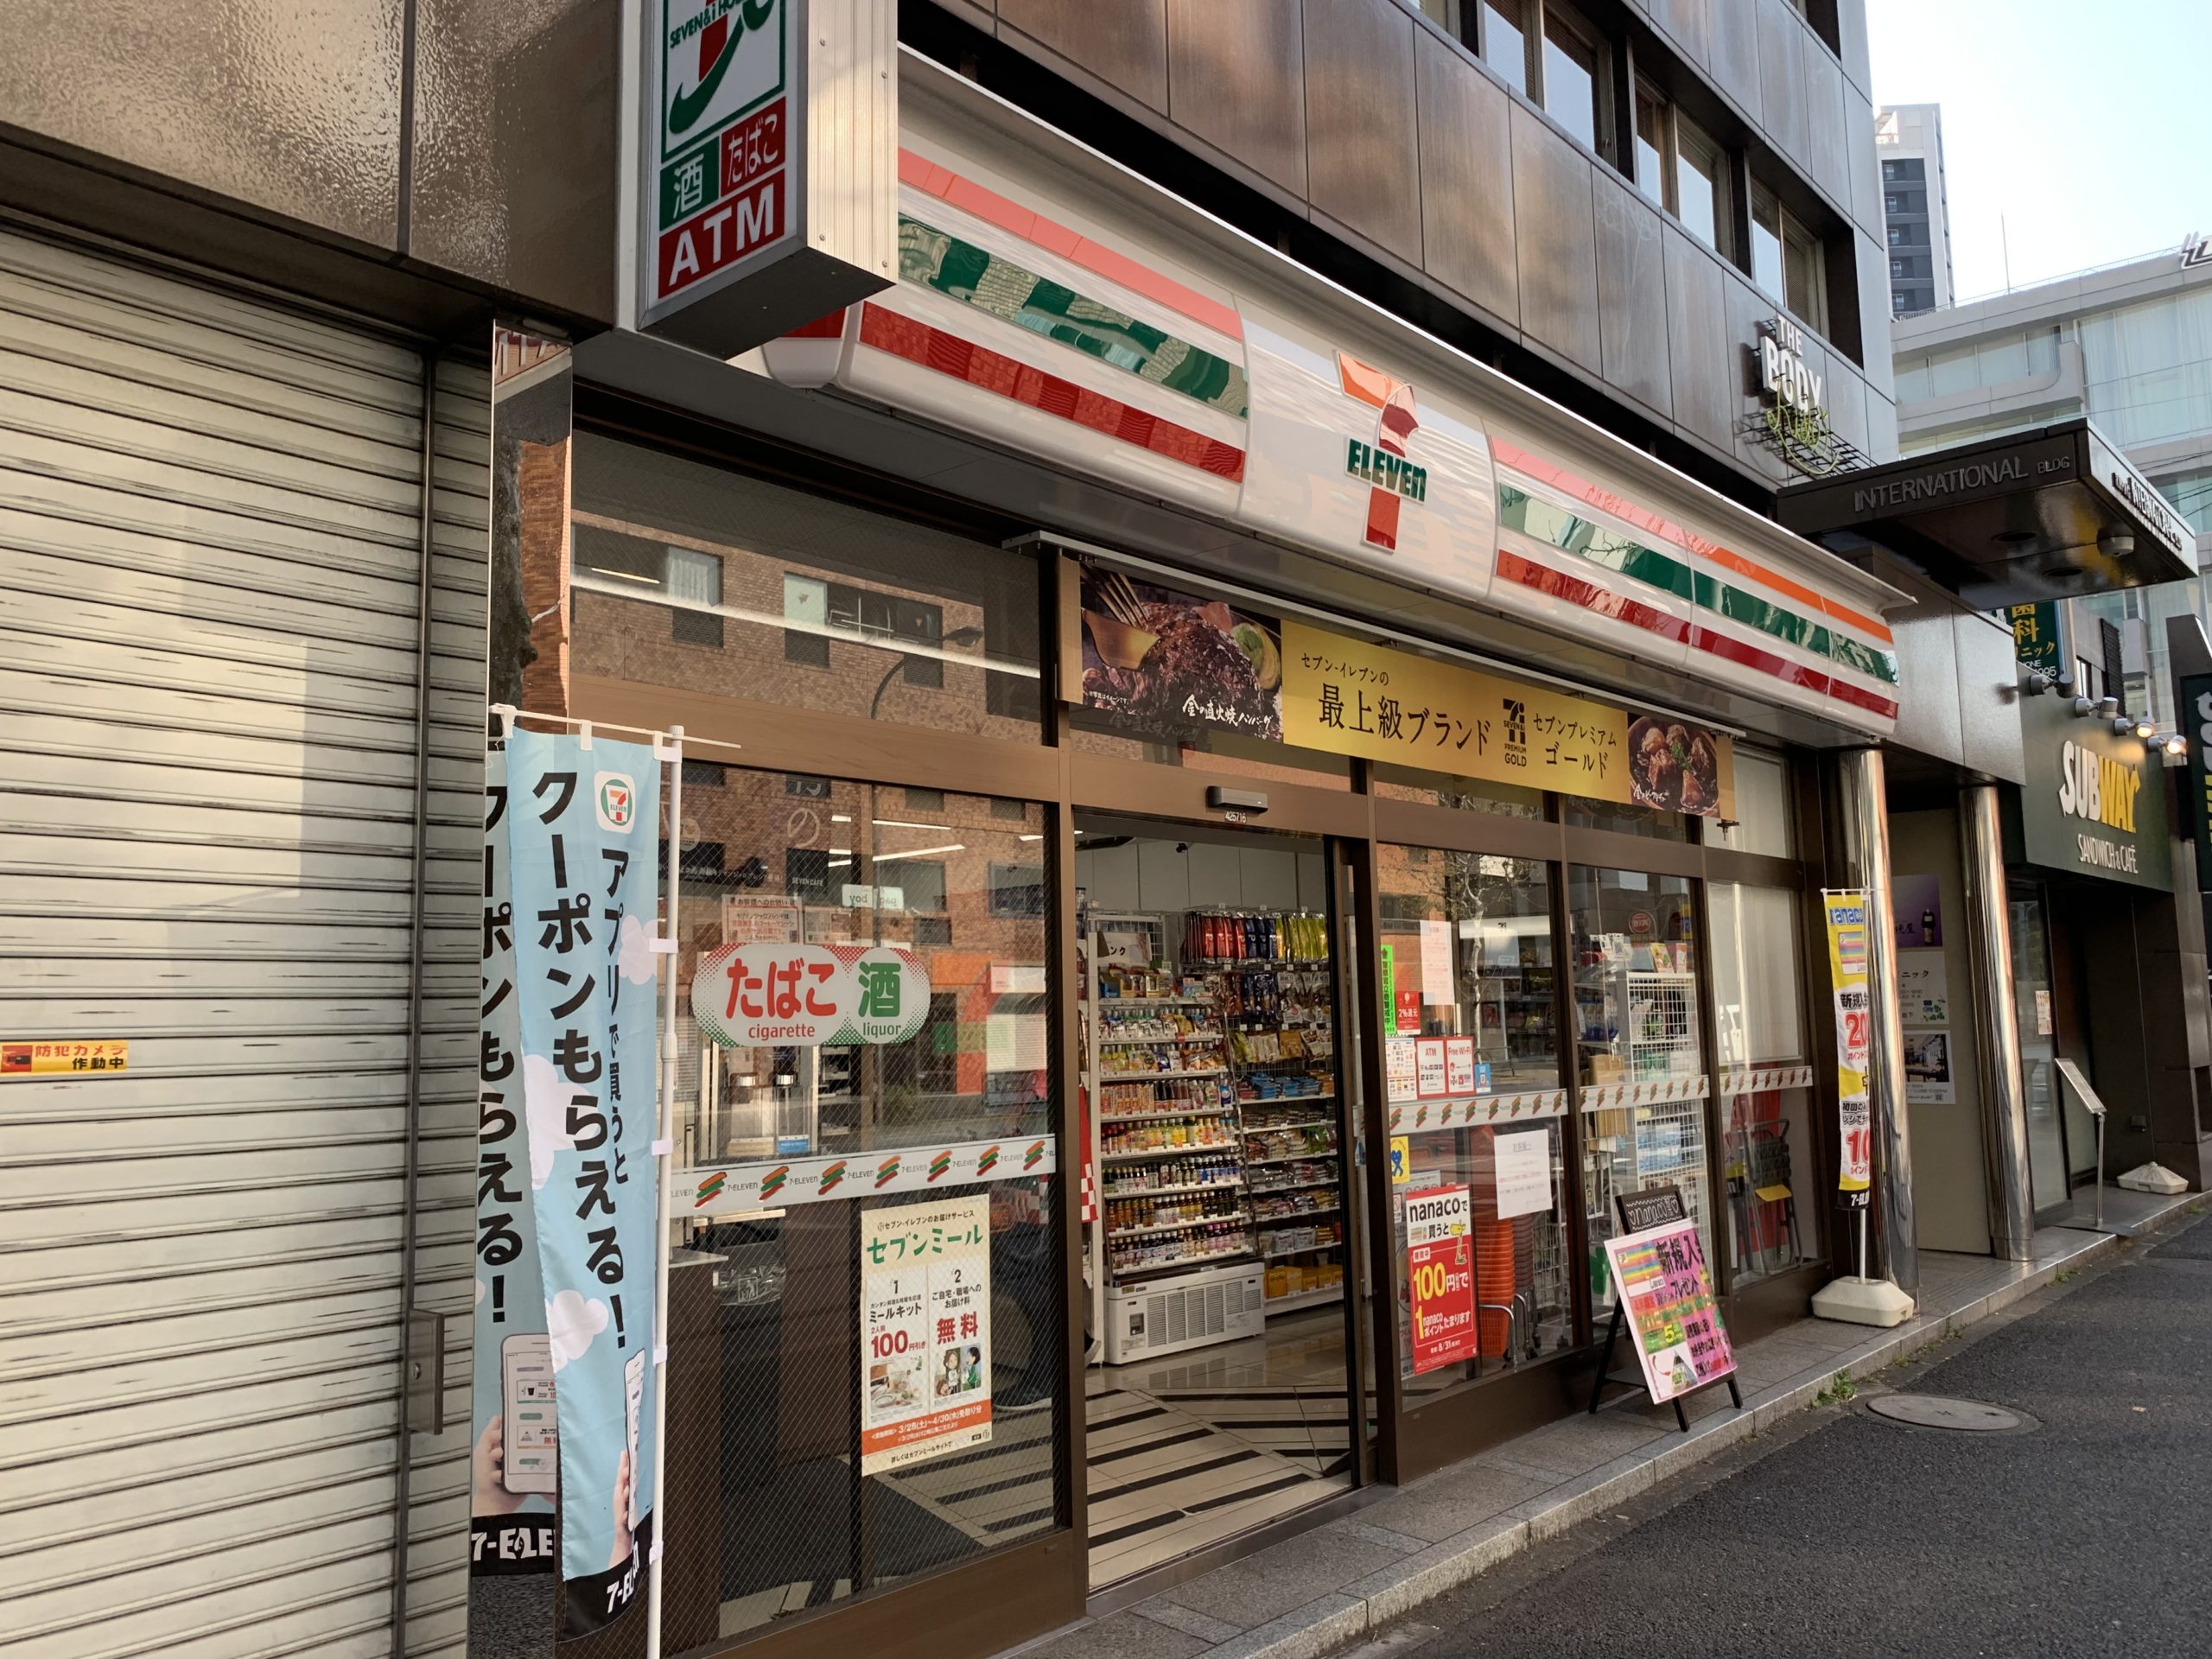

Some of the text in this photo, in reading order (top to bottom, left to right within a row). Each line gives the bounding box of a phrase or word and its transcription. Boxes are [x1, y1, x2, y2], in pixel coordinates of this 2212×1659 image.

[728, 113, 778, 188] たばこ
[673, 153, 704, 219] 酒
[668, 182, 775, 287] ATM
[1776, 315, 1802, 358] THE
[1761, 336, 1821, 420] BODY
[1854, 455, 2070, 512] INTERNATIONAL BLDG
[1318, 682, 1491, 757] 最上級ブランド
[1533, 713, 1617, 747] セブンプレミアム
[1504, 742, 1527, 754] PREMIUM
[1504, 753, 1527, 767] GOLD
[1546, 741, 1608, 779] ゴールド
[2058, 740, 2140, 833] SUBWAY
[1225, 811, 1246, 823] 425716
[2078, 833, 2116, 869] SANDWICH
[726, 957, 901, 1020] たばこ 酒
[601, 849, 629, 1185] アプリで買うと
[748, 1022, 901, 1041] cigarette liquor
[35, 1045, 127, 1057] 防犯カメラ
[73, 1057, 124, 1070] 作動中
[1425, 1046, 1437, 1058] ATM
[1448, 1047, 1459, 1056] Free
[867, 1224, 983, 1264] セブンミール
[1428, 1222, 1449, 1239] 買うと
[893, 1280, 899, 1294] 1
[954, 1268, 962, 1283] 2
[869, 1302, 922, 1323] ミールキット
[871, 1325, 886, 1334] 2人前
[937, 1311, 978, 1345] 無料
